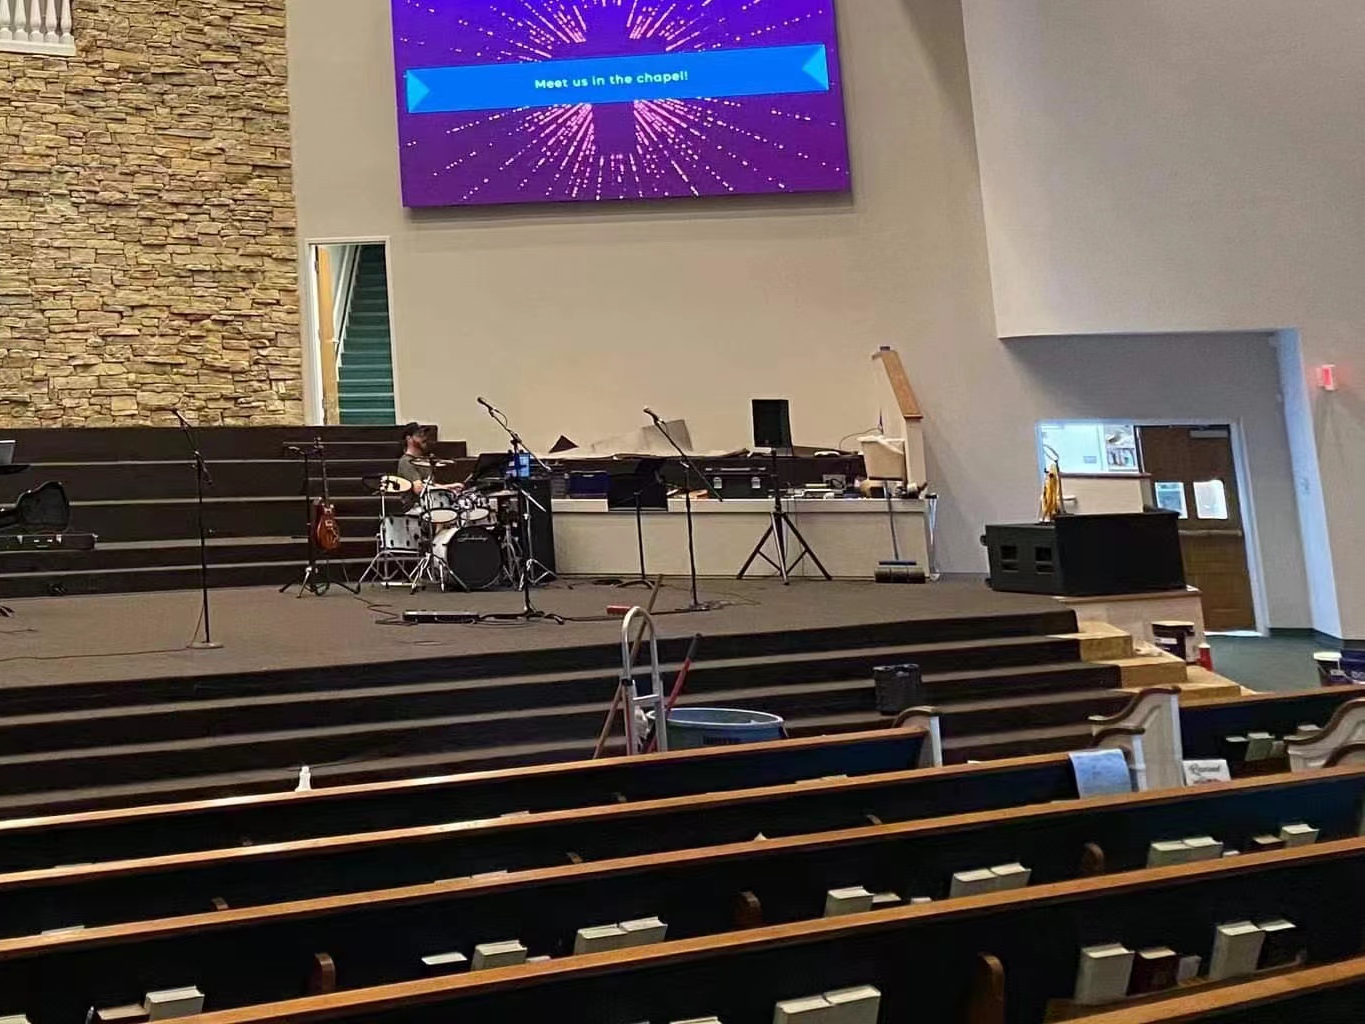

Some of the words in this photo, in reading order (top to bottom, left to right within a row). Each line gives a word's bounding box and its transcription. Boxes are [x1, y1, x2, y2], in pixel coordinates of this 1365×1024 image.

[534, 78, 568, 89] Meet
[572, 78, 588, 87] us
[592, 75, 605, 86] in
[609, 73, 633, 85] the
[636, 70, 689, 84] chapel!
